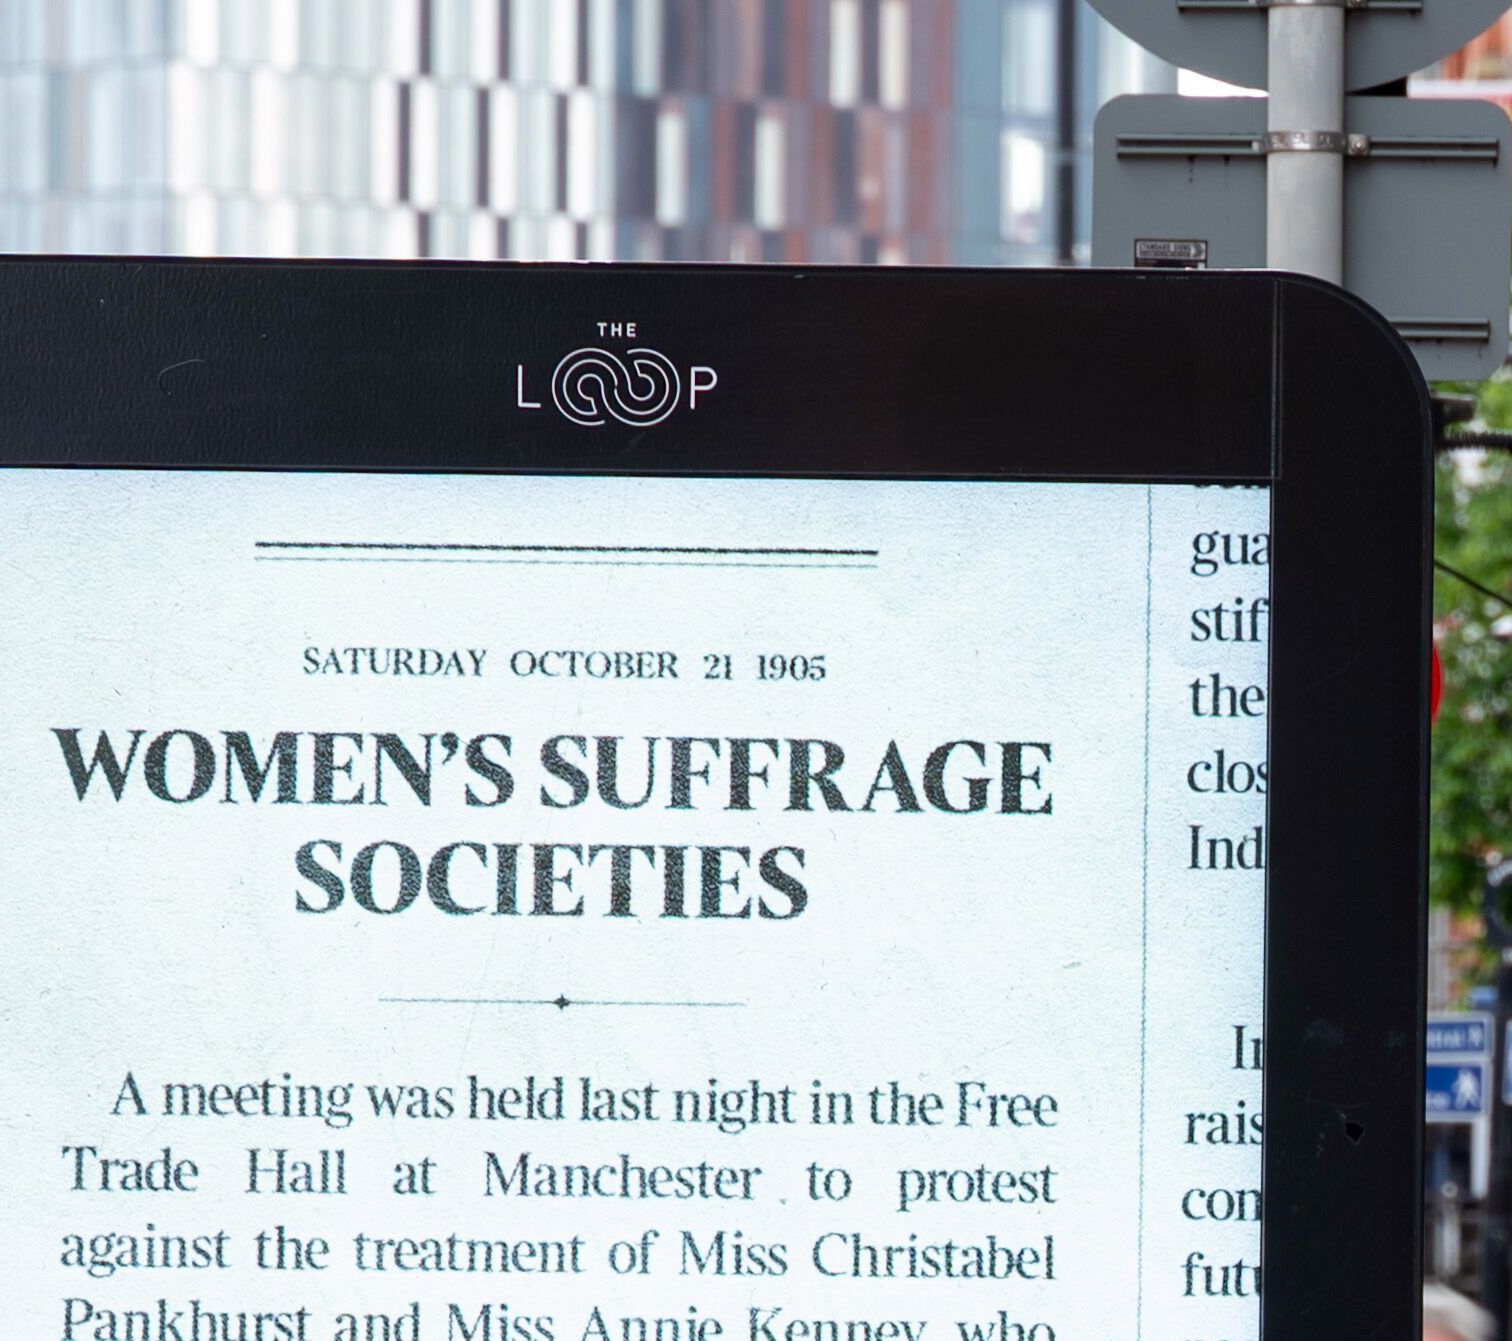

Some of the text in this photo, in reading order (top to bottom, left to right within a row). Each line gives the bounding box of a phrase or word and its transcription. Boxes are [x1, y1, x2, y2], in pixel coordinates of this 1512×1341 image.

[596, 321, 637, 339] THE
[303, 646, 827, 681] SATURDAY OCTOBER 21 1905
[49, 727, 1053, 816] WOMEN'S SUFFRAGE
[294, 838, 809, 921] SOCIETIES
[111, 1071, 1058, 1134] A meeting was held last night in the Free
[61, 1145, 1057, 1213] Trade Hall at Manchester to protest
[60, 1222, 1055, 1281] against the treatment of Miss Christabel
